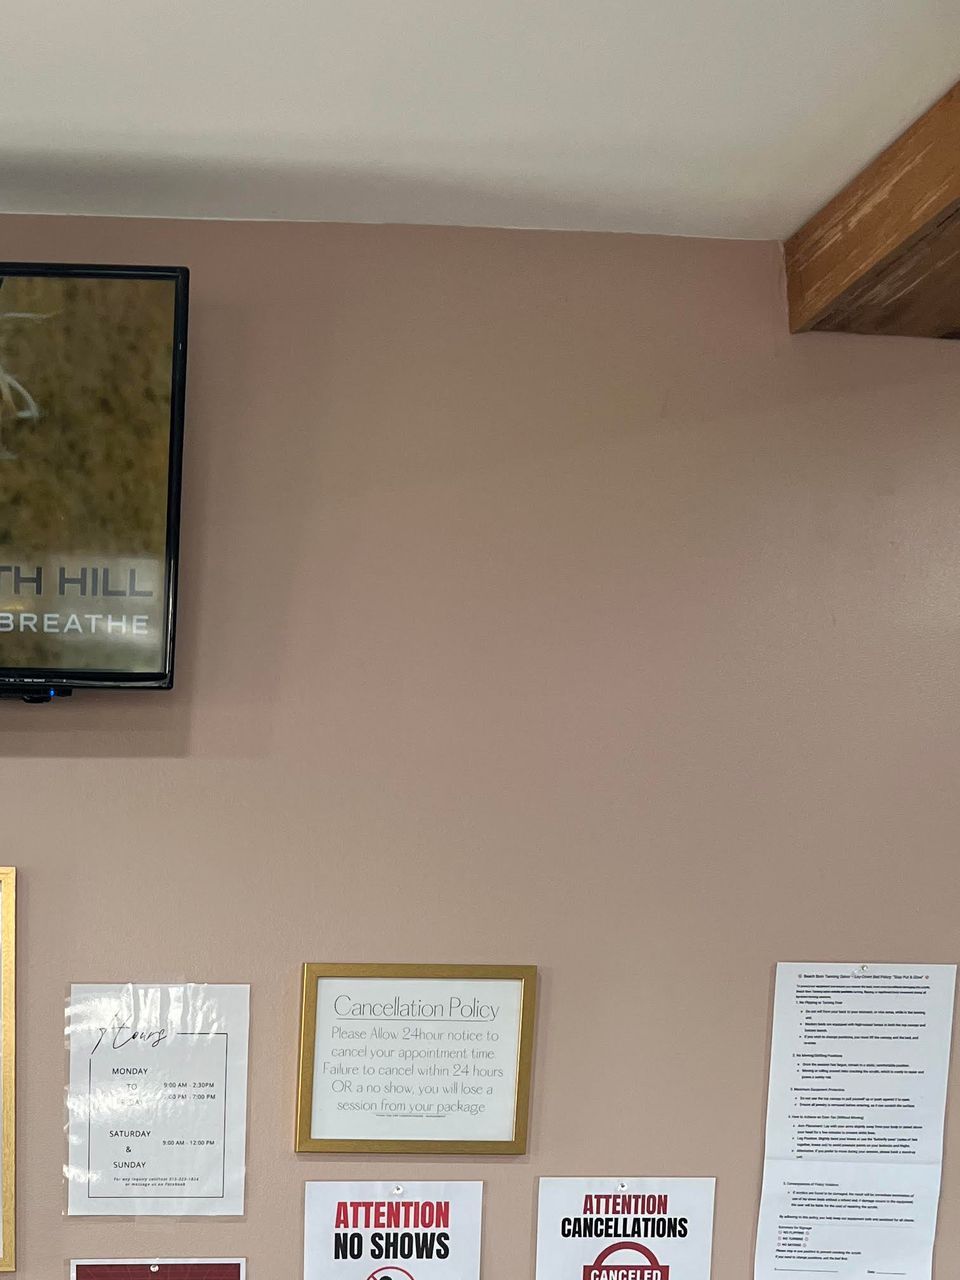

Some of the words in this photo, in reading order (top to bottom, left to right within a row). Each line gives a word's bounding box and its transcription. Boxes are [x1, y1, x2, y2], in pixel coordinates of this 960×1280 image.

[58, 567, 153, 597] HILL
[334, 995, 443, 1017] Cancellation
[449, 997, 500, 1021] Policy
[331, 1026, 366, 1040] Please
[370, 1027, 398, 1040] Allow
[402, 1027, 444, 1040] 24hour
[447, 1031, 482, 1041] notice
[487, 1031, 499, 1041] to
[331, 1046, 367, 1057] cancel
[370, 1049, 395, 1058] your
[399, 1047, 468, 1060] appointment
[323, 1062, 359, 1075] Failure
[363, 1065, 375, 1075] to
[379, 1064, 413, 1075] cancel
[418, 1065, 449, 1076] within
[452, 1064, 468, 1076] 24
[473, 1065, 503, 1077] hours
[332, 1080, 352, 1093] OR
[357, 1084, 363, 1093] a
[366, 1085, 381, 1093] no
[384, 1082, 414, 1095] show,
[419, 1084, 438, 1095] you
[442, 1082, 458, 1094] will
[461, 1082, 483, 1095] lose
[486, 1087, 493, 1095] a
[337, 1099, 377, 1111] session
[381, 1099, 405, 1111] from
[409, 1102, 433, 1113] your
[437, 1100, 486, 1115] package
[335, 1201, 450, 1228] ATTENTION
[583, 1194, 668, 1215] ATTENTION
[561, 1217, 688, 1238] CANCELLATIONS
[334, 1233, 363, 1259] NO
[371, 1232, 450, 1259] SHOWS
